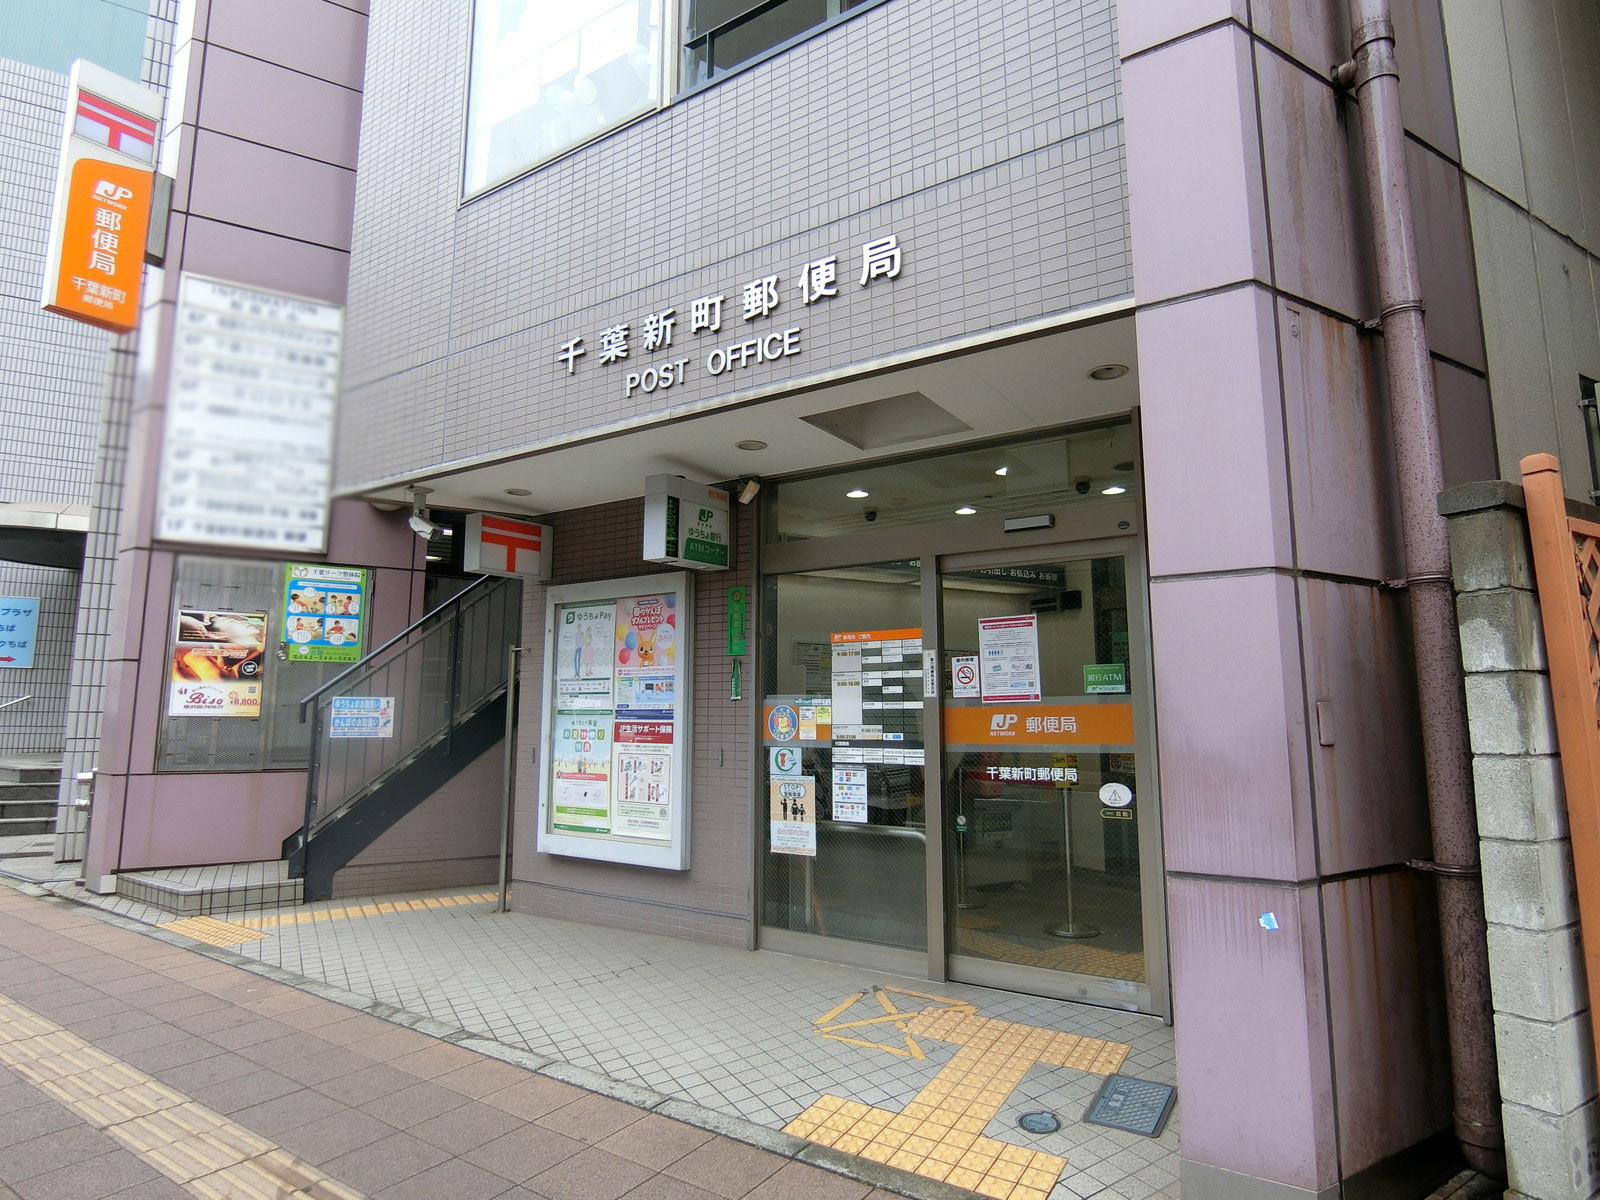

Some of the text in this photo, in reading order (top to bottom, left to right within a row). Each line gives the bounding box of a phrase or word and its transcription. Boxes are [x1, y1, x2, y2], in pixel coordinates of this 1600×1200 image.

[88, 207, 122, 276] 郵便局
[72, 276, 127, 304] 千葉新町
[558, 233, 902, 374] 千葉新町郵便局
[625, 326, 802, 398] POST OFFICE
[688, 527, 722, 543] ゆうちょ銀行
[689, 542, 725, 556] ATMコーナー
[313, 569, 361, 579] 千葉リーフ整体院
[1009, 567, 1036, 579] お払込み
[577, 611, 612, 621] ゆうちょPay
[619, 724, 673, 734] JP生活サポート保険
[1025, 716, 1077, 734] 郵便局
[985, 766, 1078, 782] 千葉新町郵便局
